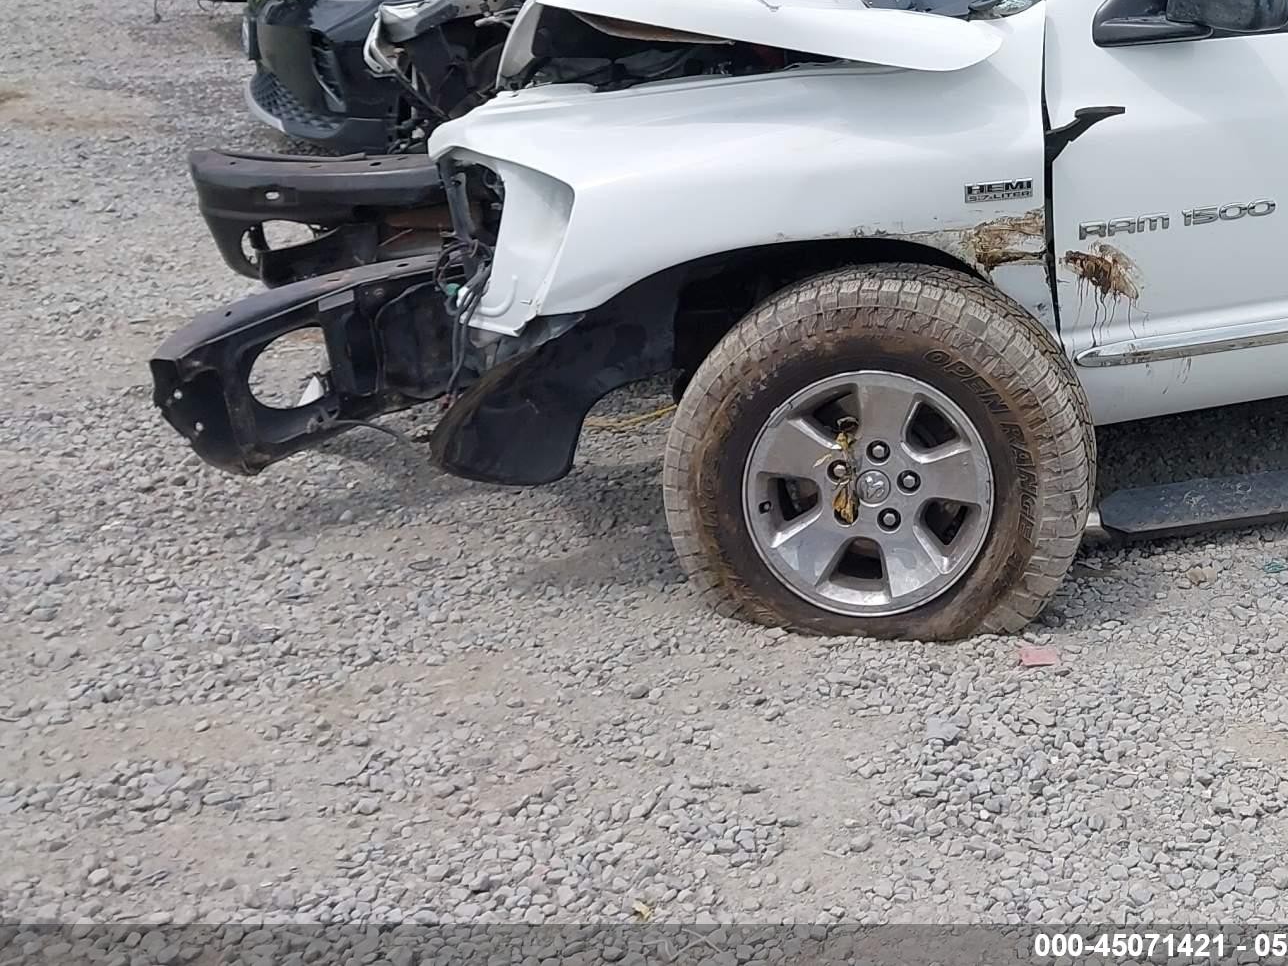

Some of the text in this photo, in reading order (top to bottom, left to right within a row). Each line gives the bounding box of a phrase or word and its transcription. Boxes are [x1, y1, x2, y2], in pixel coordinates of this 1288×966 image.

[965, 178, 1033, 195] HEMI
[1079, 198, 1276, 240] RAM 1500
[922, 348, 1039, 543] OPEN RANGE
